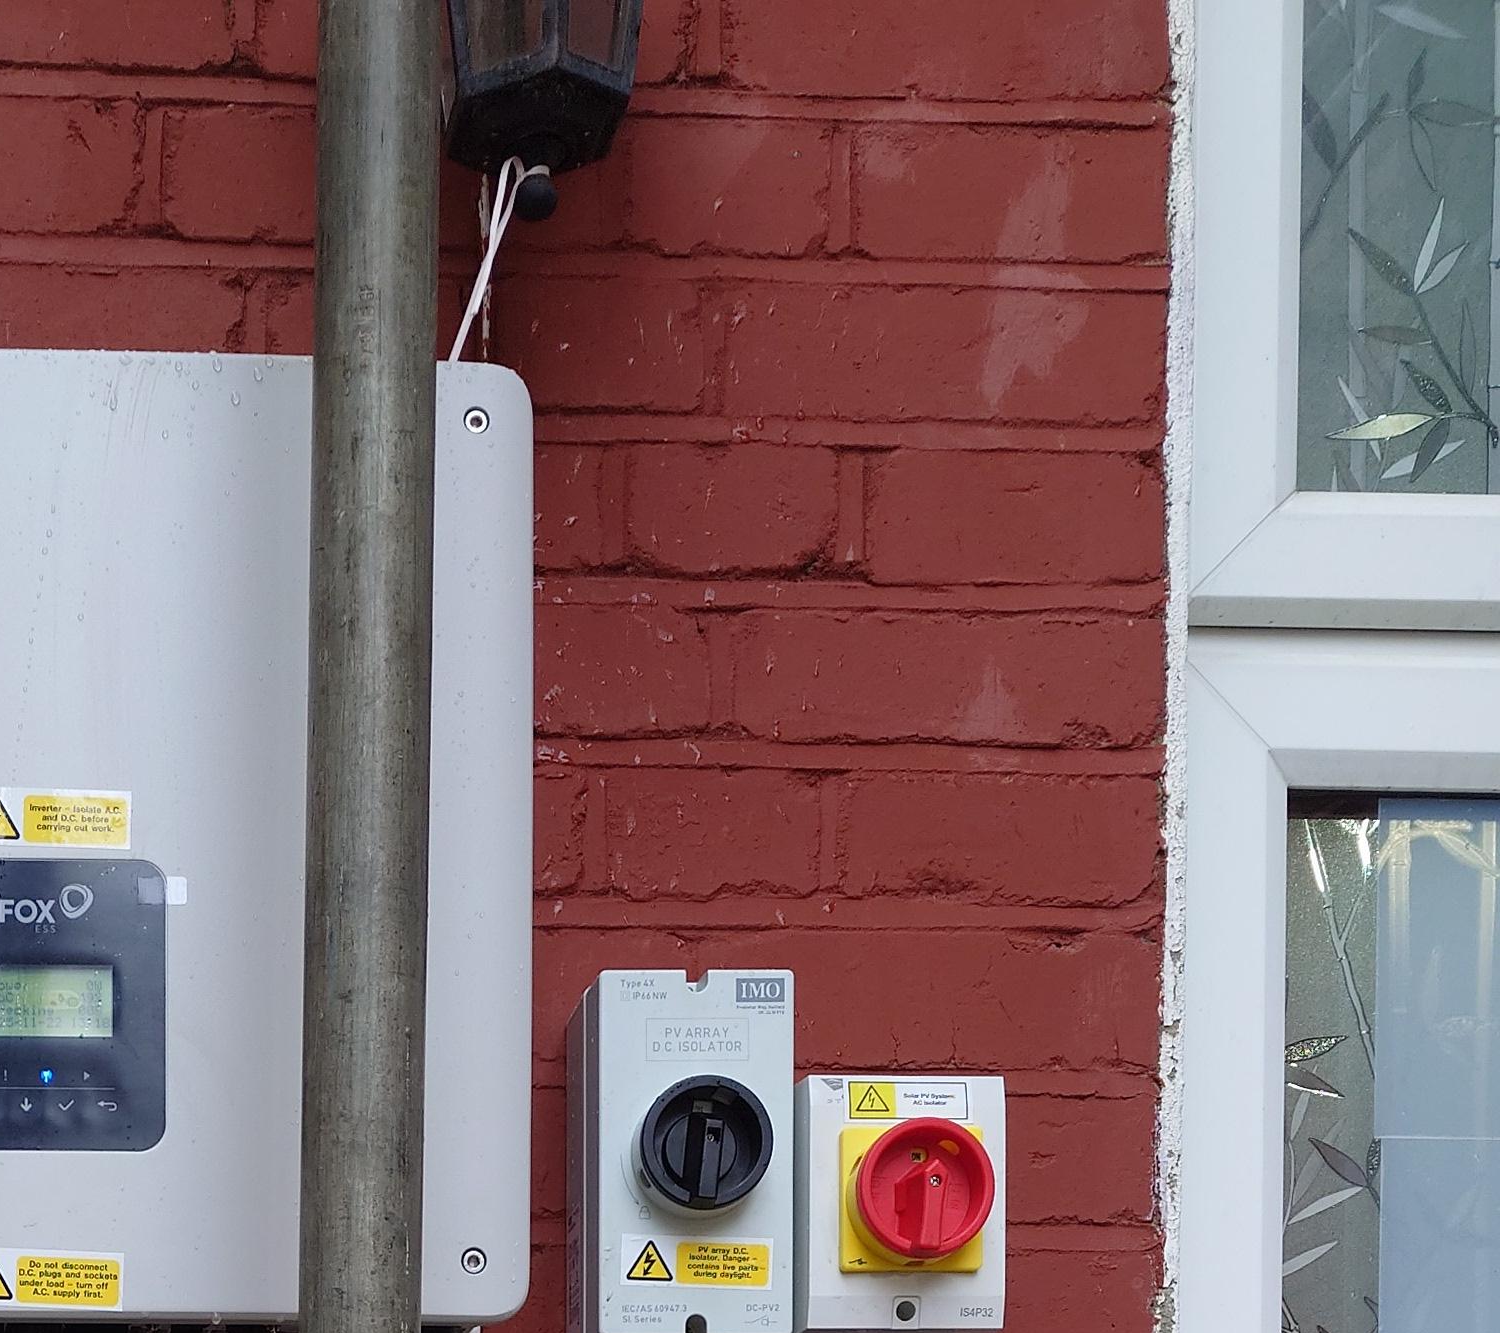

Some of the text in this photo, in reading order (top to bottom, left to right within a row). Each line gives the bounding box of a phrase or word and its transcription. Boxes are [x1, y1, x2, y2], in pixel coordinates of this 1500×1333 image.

[29, 803, 62, 812] Inverter
[104, 806, 122, 815] A.C.
[41, 814, 110, 823] and D.C. before
[36, 823, 115, 833] carrying out work.
[0, 899, 56, 924] FOX
[35, 924, 57, 934] ESS
[620, 979, 655, 990] Type 4X
[740, 982, 781, 998] IMO
[664, 1027, 729, 1038] PV ARRAY
[678, 1041, 742, 1052] ISOLATOR
[711, 1247, 731, 1255] array
[733, 1247, 749, 1255] D.C.
[722, 1254, 750, 1263] Danger
[29, 1260, 108, 1271] Do not disconnect
[722, 1263, 736, 1271] live
[738, 1264, 759, 1272] parts
[18, 1268, 118, 1281] D.C. plugs and sockets
[693, 1270, 717, 1278] during
[19, 1279, 43, 1287] under
[46, 1280, 65, 1288] load
[96, 1282, 109, 1290] off
[32, 1288, 103, 1299] A.C. supply first.
[746, 1303, 781, 1312] DC-PV2
[960, 1307, 994, 1318] IS4P32
[634, 1315, 662, 1323] Series
